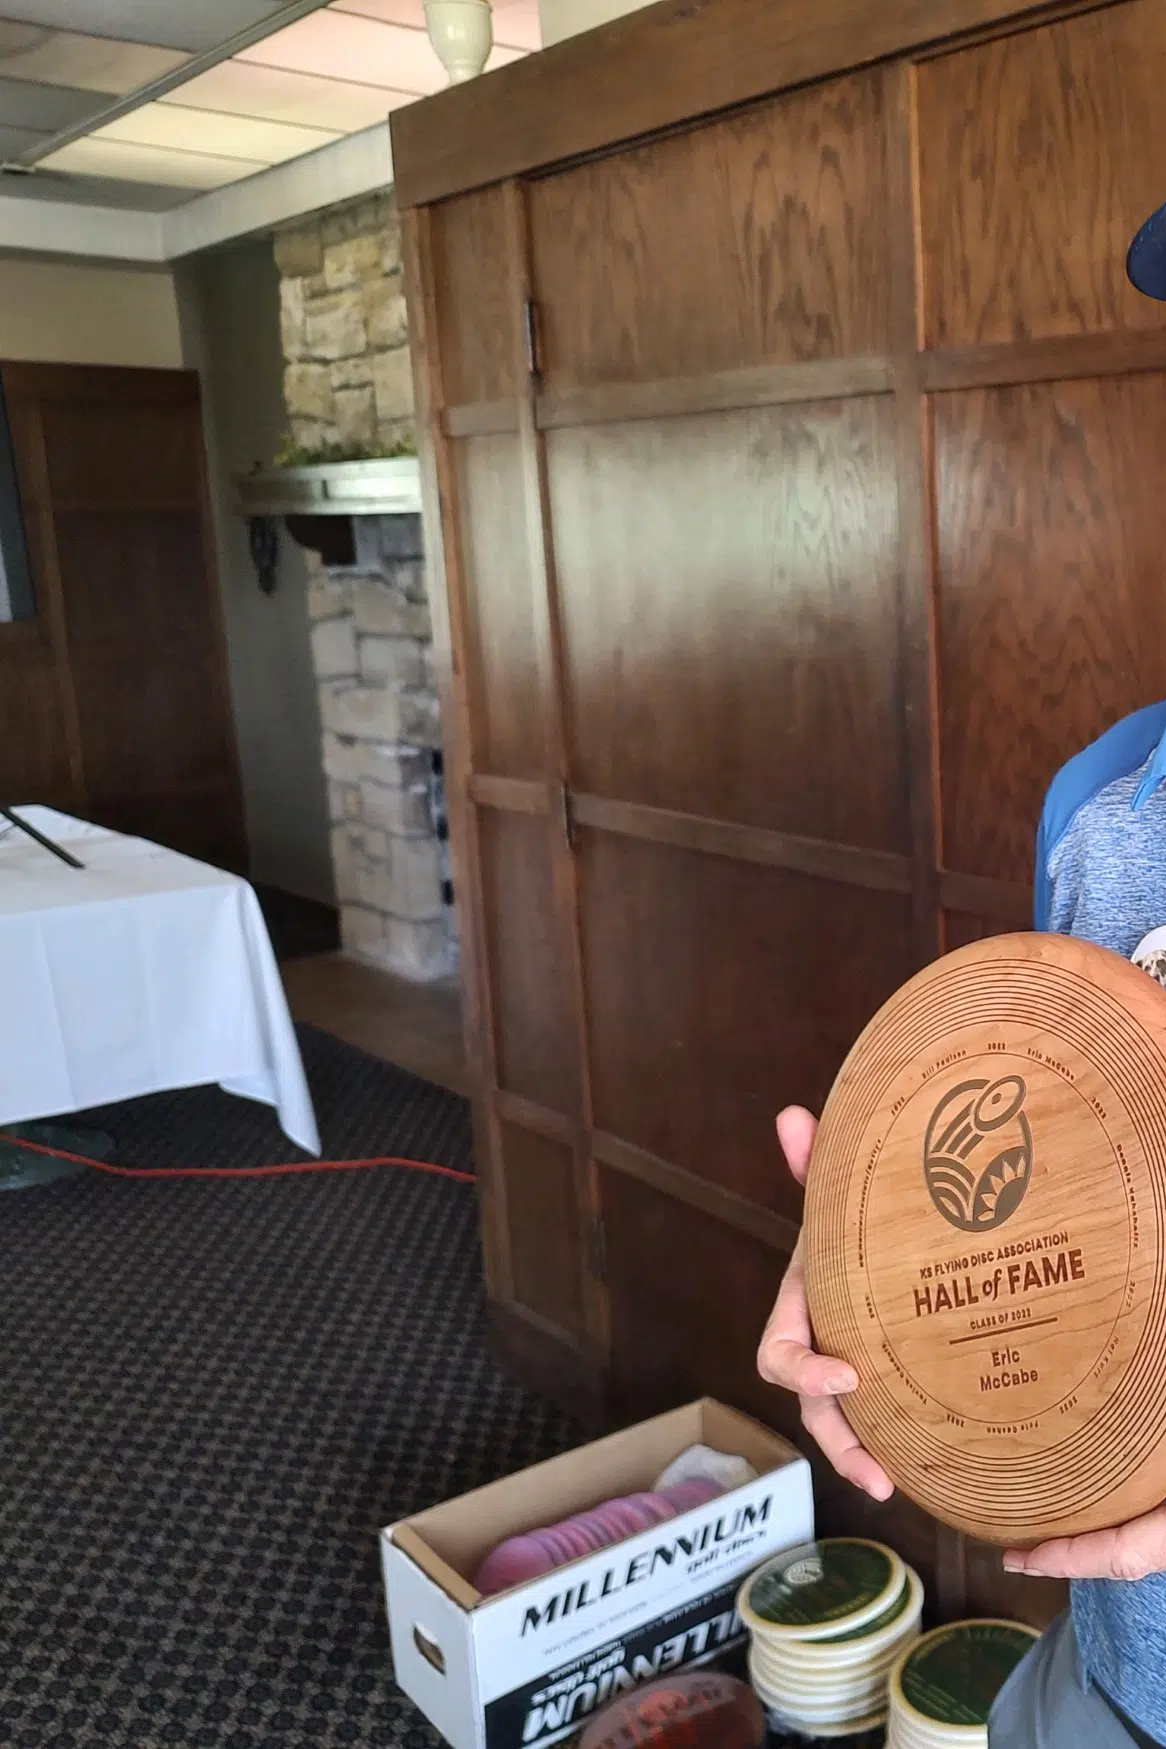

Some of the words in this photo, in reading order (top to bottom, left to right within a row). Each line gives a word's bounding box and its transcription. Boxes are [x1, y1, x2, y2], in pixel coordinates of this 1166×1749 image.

[919, 1267, 933, 1280] KS
[934, 1256, 969, 1277] FLYING
[970, 1250, 995, 1268] DISC
[996, 1230, 1070, 1262] ASSOCIATION
[912, 1275, 980, 1318] HALL
[982, 1268, 1003, 1302] of
[1007, 1248, 1086, 1296] FAME
[970, 1315, 997, 1330] CLASS
[998, 1312, 1009, 1324] OF
[1011, 1307, 1032, 1321] 2022
[991, 1346, 1021, 1368] Eric
[979, 1368, 1039, 1392] McCabe
[520, 1493, 773, 1638] MILLENNIUM
